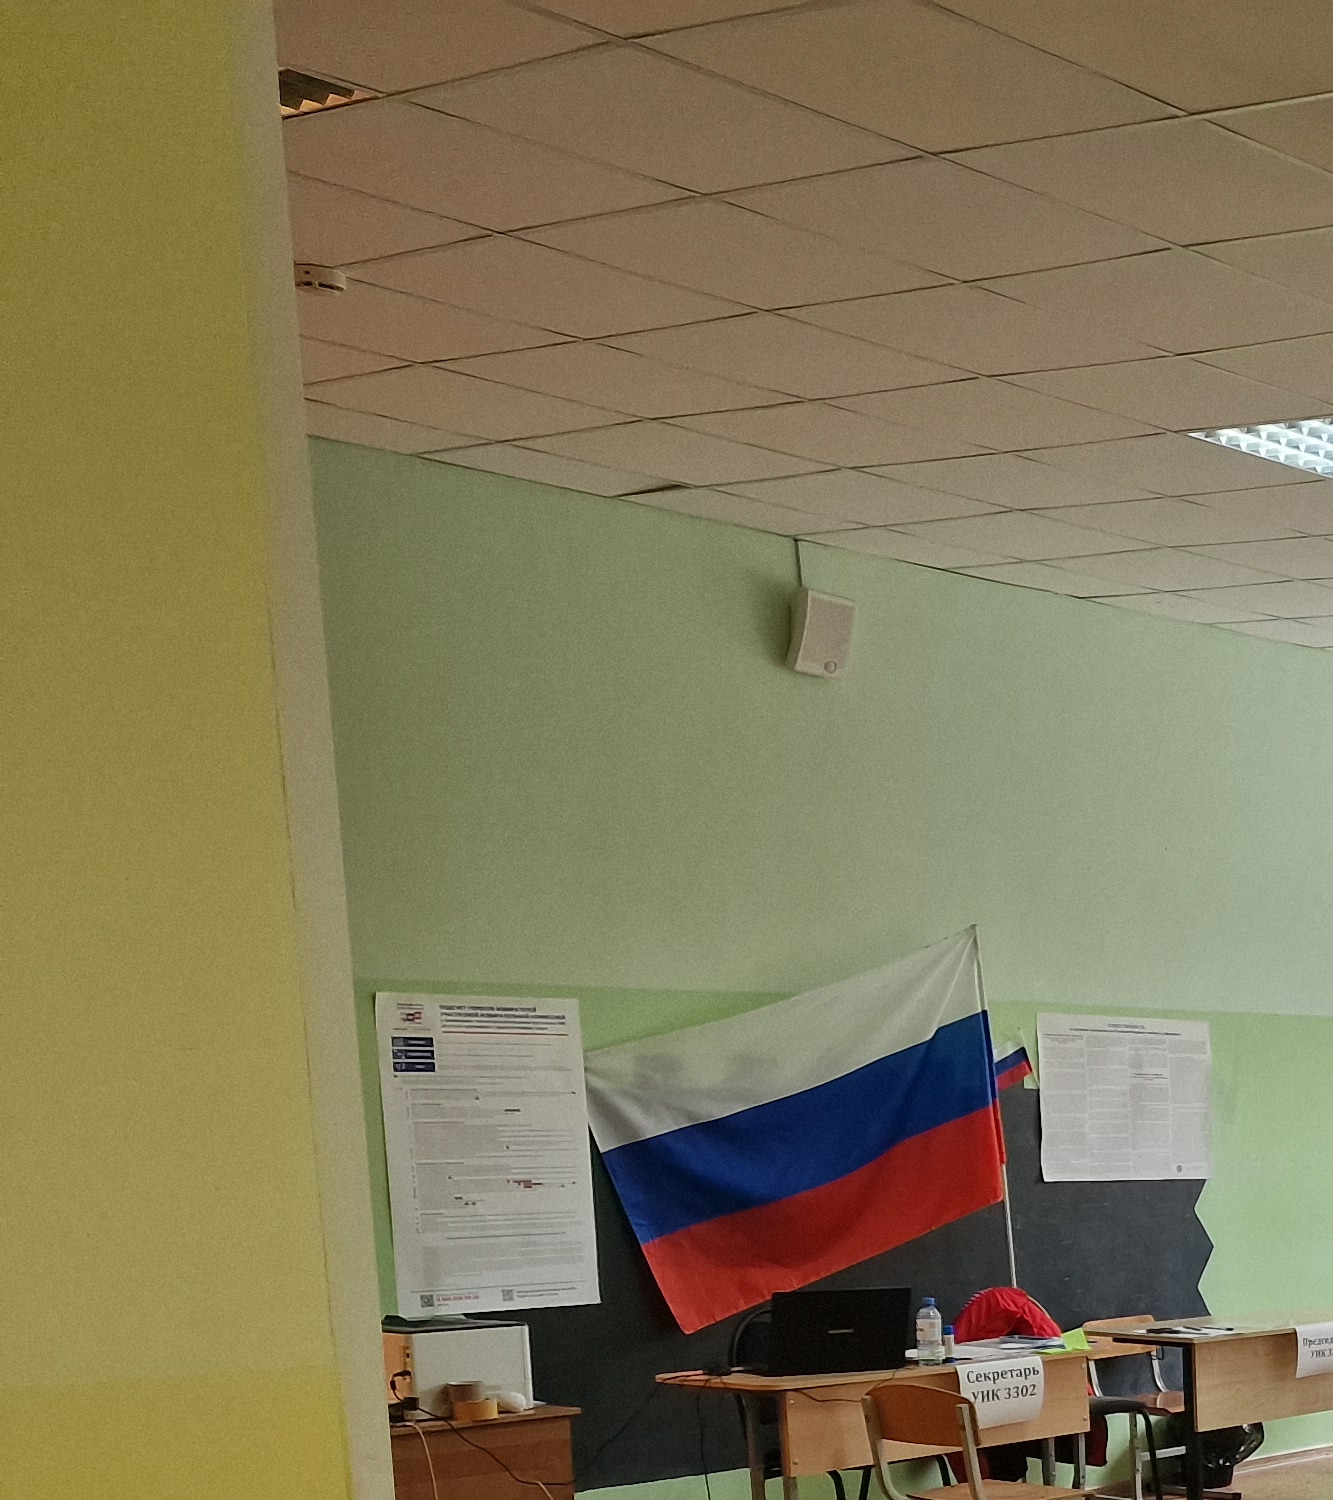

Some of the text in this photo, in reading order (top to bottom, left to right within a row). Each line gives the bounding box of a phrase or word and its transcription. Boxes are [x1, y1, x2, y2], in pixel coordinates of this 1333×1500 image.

[966, 1366, 1040, 1385] Секретарь
[970, 1383, 1037, 1405] УИК 3302
